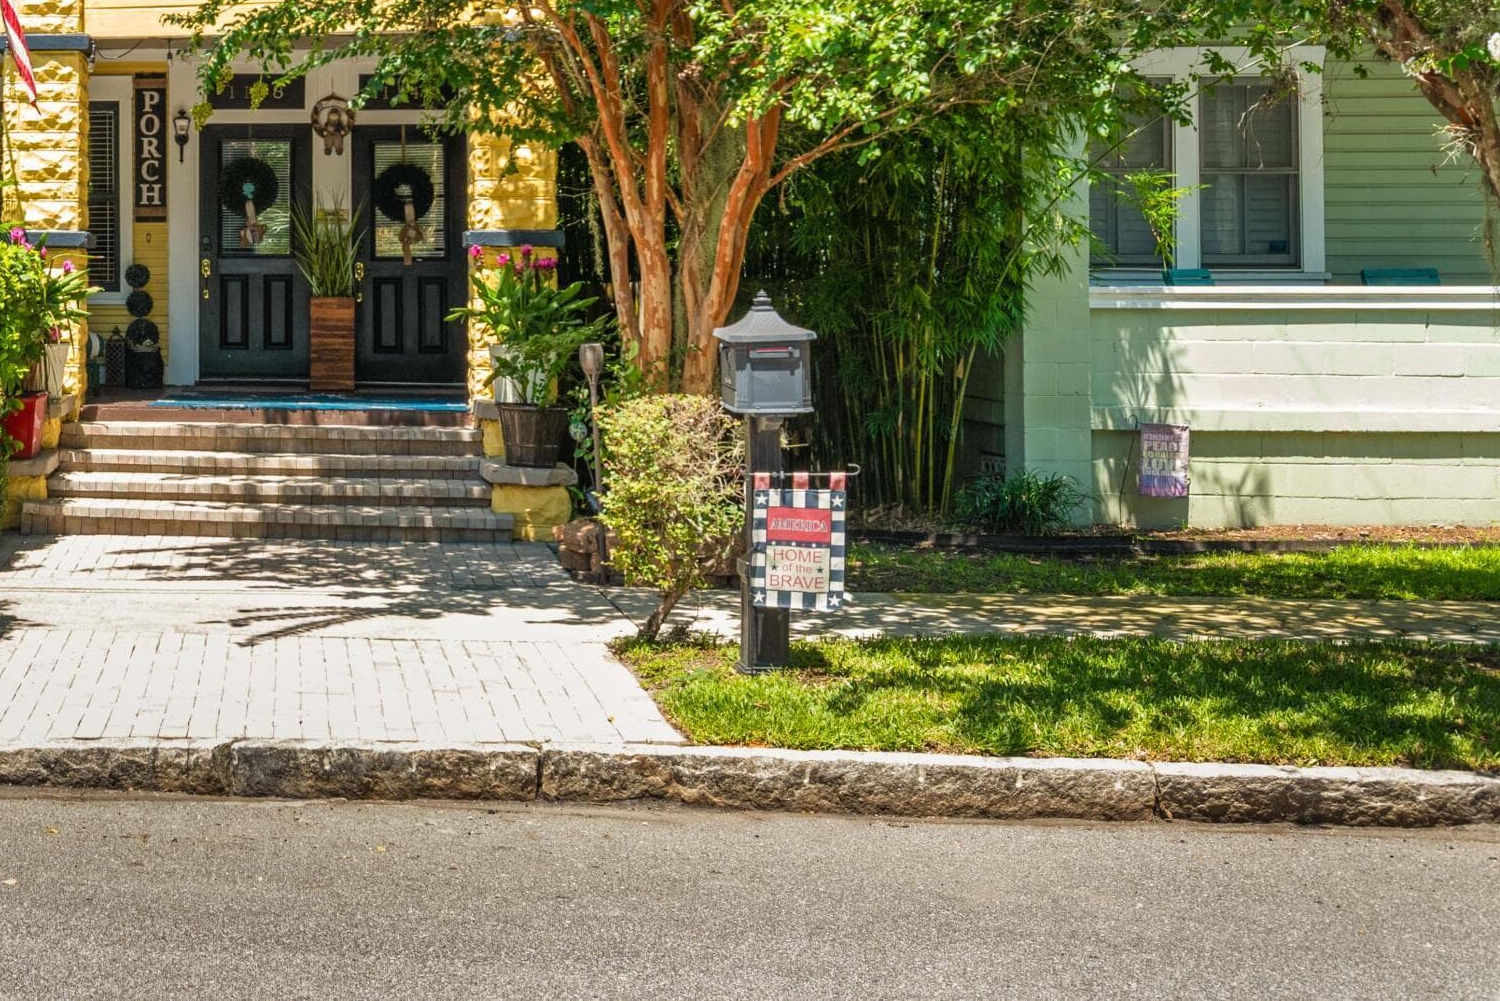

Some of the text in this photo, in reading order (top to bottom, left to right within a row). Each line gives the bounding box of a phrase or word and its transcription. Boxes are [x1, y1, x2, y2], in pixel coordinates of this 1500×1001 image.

[140, 91, 162, 205] PORCH
[770, 518, 828, 533] AMERICA
[773, 549, 822, 564] HOME
[782, 563, 813, 574] of the
[769, 575, 825, 590] BRAVE
